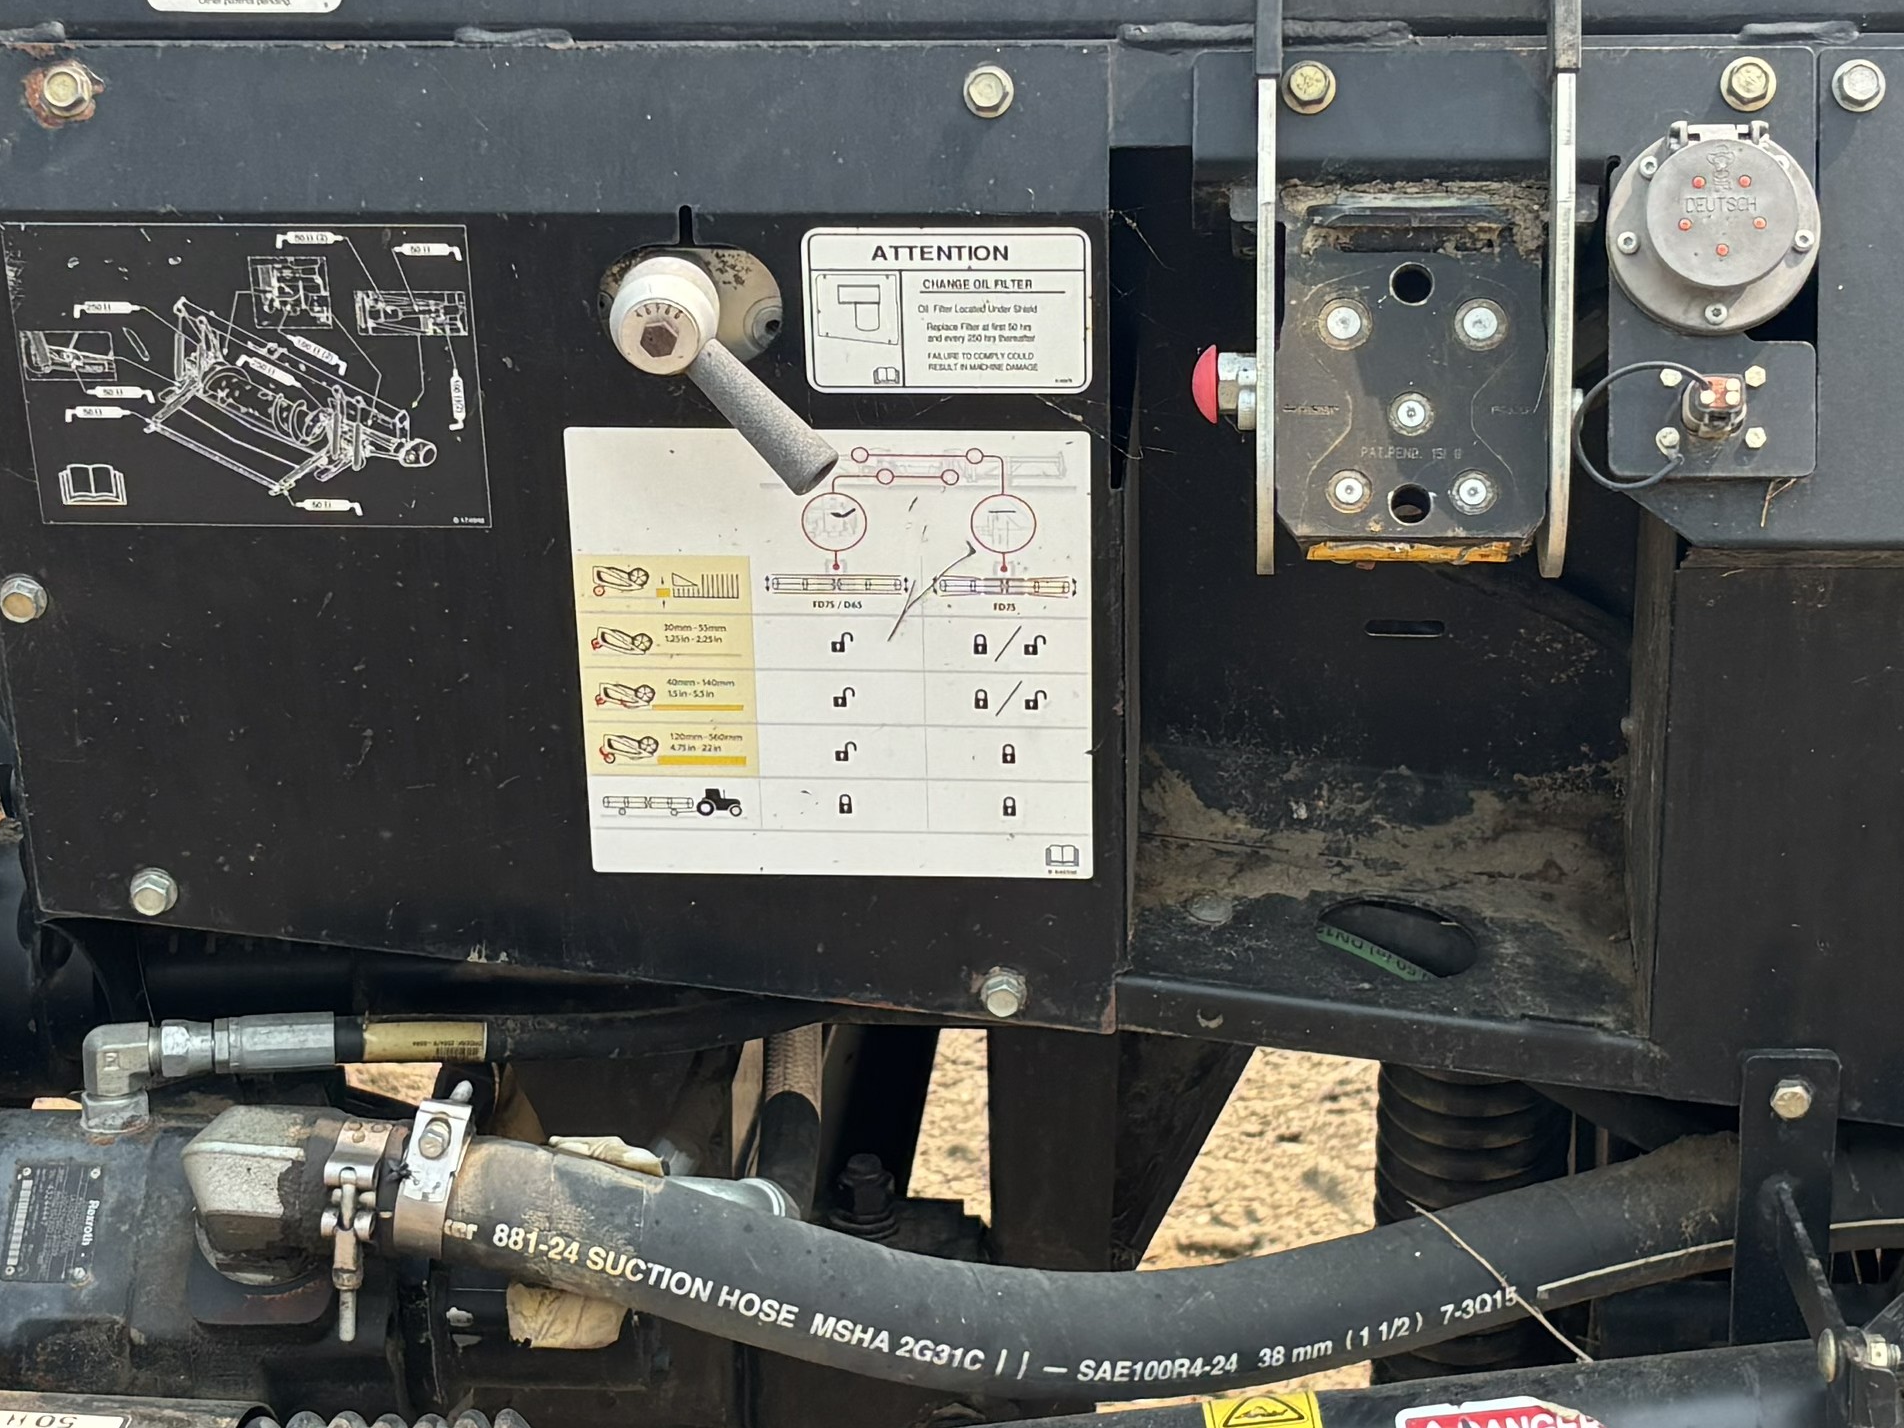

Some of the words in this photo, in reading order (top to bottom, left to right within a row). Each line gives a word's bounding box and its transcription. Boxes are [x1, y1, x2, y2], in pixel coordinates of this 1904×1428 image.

[1684, 196, 1758, 214] DEUTSCH
[871, 245, 1009, 261] ATTENTION
[922, 279, 970, 290] CHANGE
[973, 279, 991, 290] OIL
[994, 279, 1033, 290] FILTER
[917, 304, 929, 313] Oil
[933, 304, 953, 313] Filter
[954, 303, 987, 313] Located
[987, 304, 1011, 313] Under
[1013, 304, 1038, 314] Shield
[926, 322, 958, 332] Replace
[960, 322, 980, 331] Filter
[927, 334, 943, 342] and
[944, 335, 965, 344] every
[927, 352, 959, 360] FAILURE
[962, 352, 972, 360] TO
[973, 352, 1005, 360] COMPLY
[1007, 352, 1034, 360] COULD
[928, 363, 959, 371] RESULT
[969, 363, 1003, 371] MACHINE
[1005, 363, 1038, 371] DAMAGE
[81, 1199, 101, 1247] Rexroth
[492, 1223, 581, 1265] 881-24
[585, 1246, 715, 1303] SUCTION
[717, 1284, 800, 1329] HOSE
[809, 1312, 891, 1354] MSHA
[895, 1335, 986, 1372] 2G31C
[1076, 1352, 1239, 1382] SAE100R4-24
[1257, 1345, 1285, 1368] 38
[1291, 1339, 1333, 1364] mm
